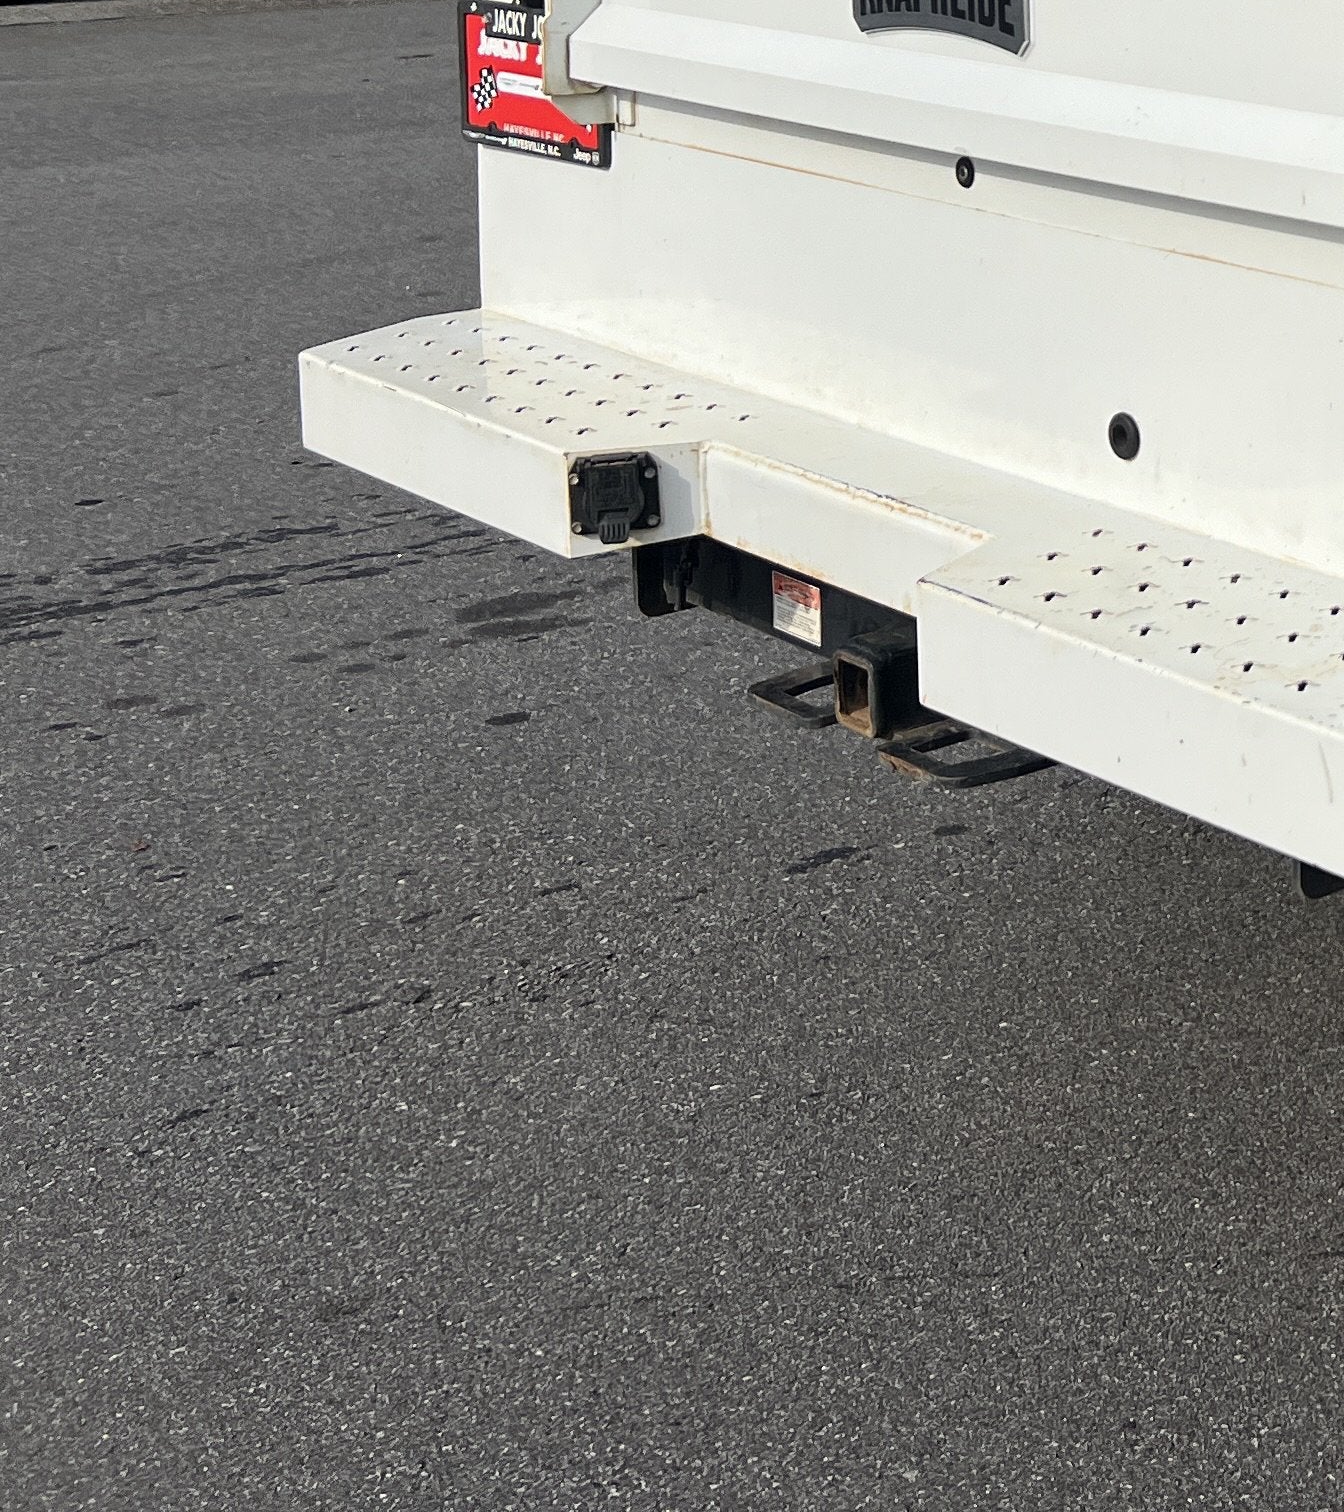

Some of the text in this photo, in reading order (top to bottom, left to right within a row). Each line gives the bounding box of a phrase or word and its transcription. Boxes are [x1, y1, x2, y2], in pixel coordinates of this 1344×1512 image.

[492, 8, 545, 40] JACKY JO
[573, 148, 592, 165] Jeep
